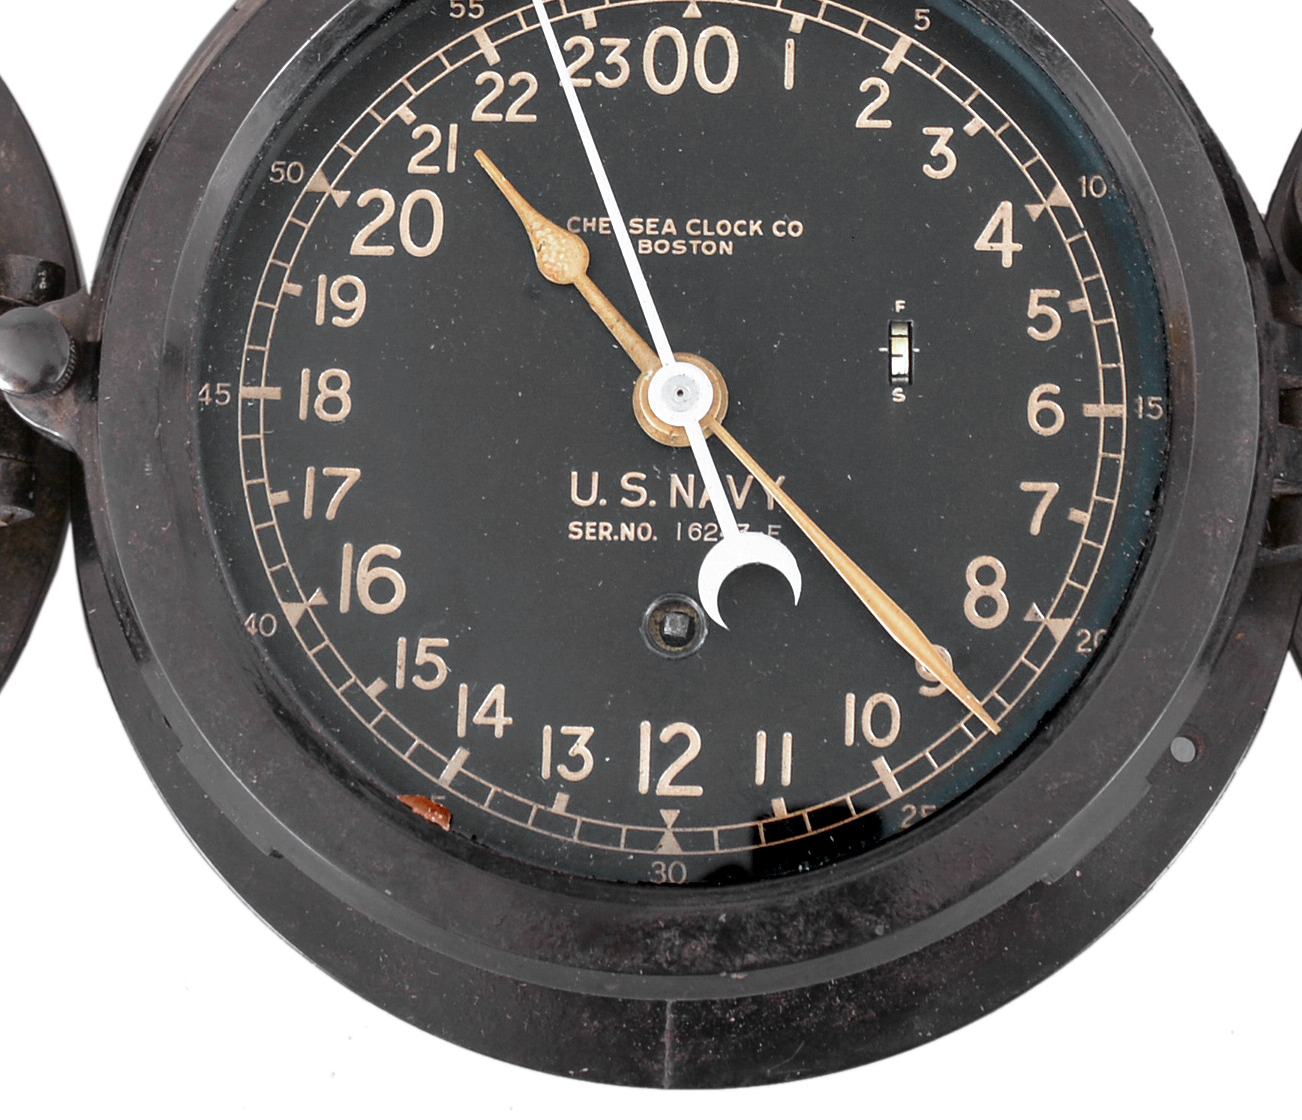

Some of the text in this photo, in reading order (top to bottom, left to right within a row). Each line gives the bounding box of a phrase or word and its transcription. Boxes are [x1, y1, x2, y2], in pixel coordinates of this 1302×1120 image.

[914, 8, 931, 31] 5
[559, 35, 631, 89] 23
[643, 25, 739, 96] 00
[269, 161, 305, 184] 50
[407, 123, 458, 175] 21
[1079, 175, 1108, 199] 10
[350, 188, 445, 258] 20
[566, 216, 804, 238] CHESEA CLOCK CO
[637, 239, 733, 256] BOSTON
[973, 200, 1024, 268] 4
[895, 300, 906, 313] F
[197, 383, 232, 406] 45
[299, 368, 352, 422] 18
[892, 387, 906, 403] S
[1027, 383, 1065, 436] 6
[1134, 396, 1164, 420] 15
[339, 542, 407, 615] 16
[963, 555, 1010, 629] 8
[243, 613, 278, 637] 40
[395, 636, 450, 691] 15
[844, 692, 901, 748] 10
[638, 720, 704, 797] 12
[650, 861, 687, 884] 30
